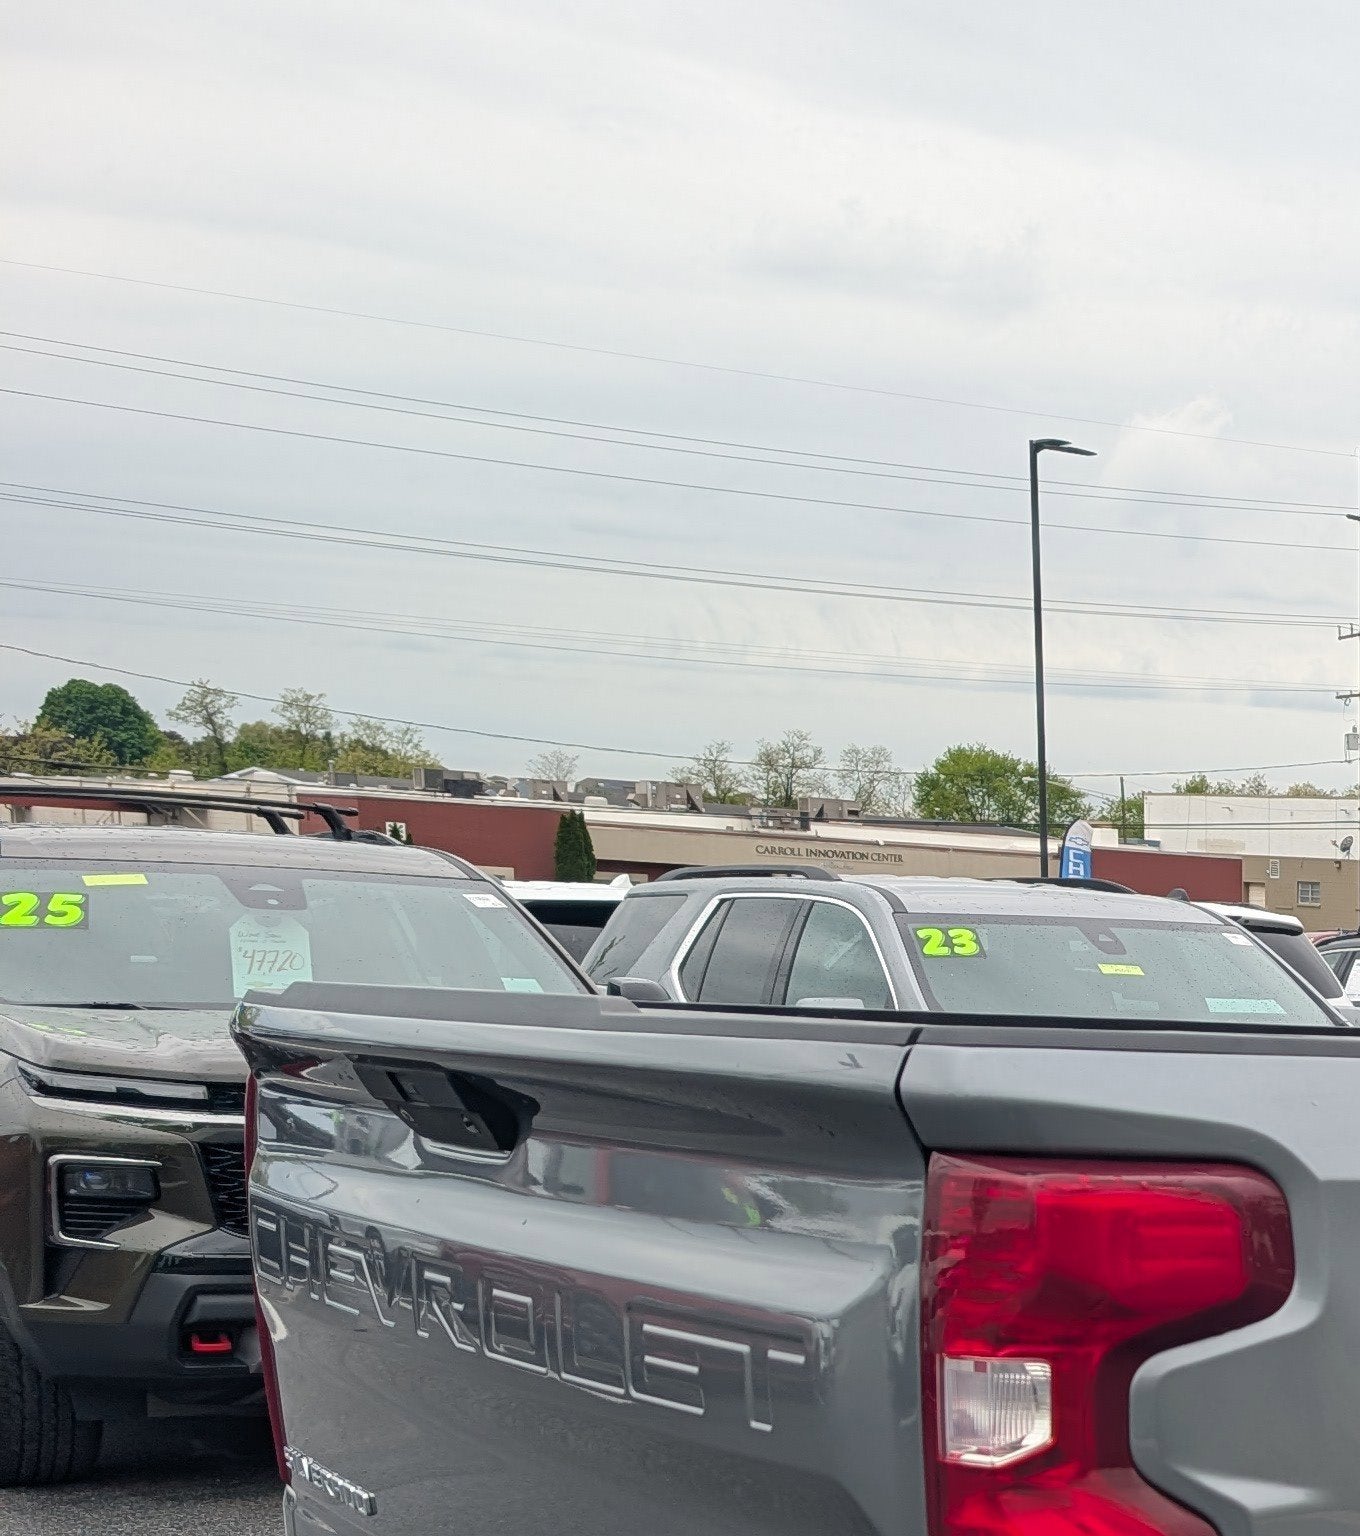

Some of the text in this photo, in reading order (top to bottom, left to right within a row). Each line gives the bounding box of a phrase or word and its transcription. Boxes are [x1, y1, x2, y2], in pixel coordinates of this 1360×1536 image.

[755, 844, 904, 863] CARROLL INNOVATION CENTER
[0, 892, 86, 927] 25
[916, 928, 980, 956] 23
[250, 1202, 808, 1434] CHEVROLET
